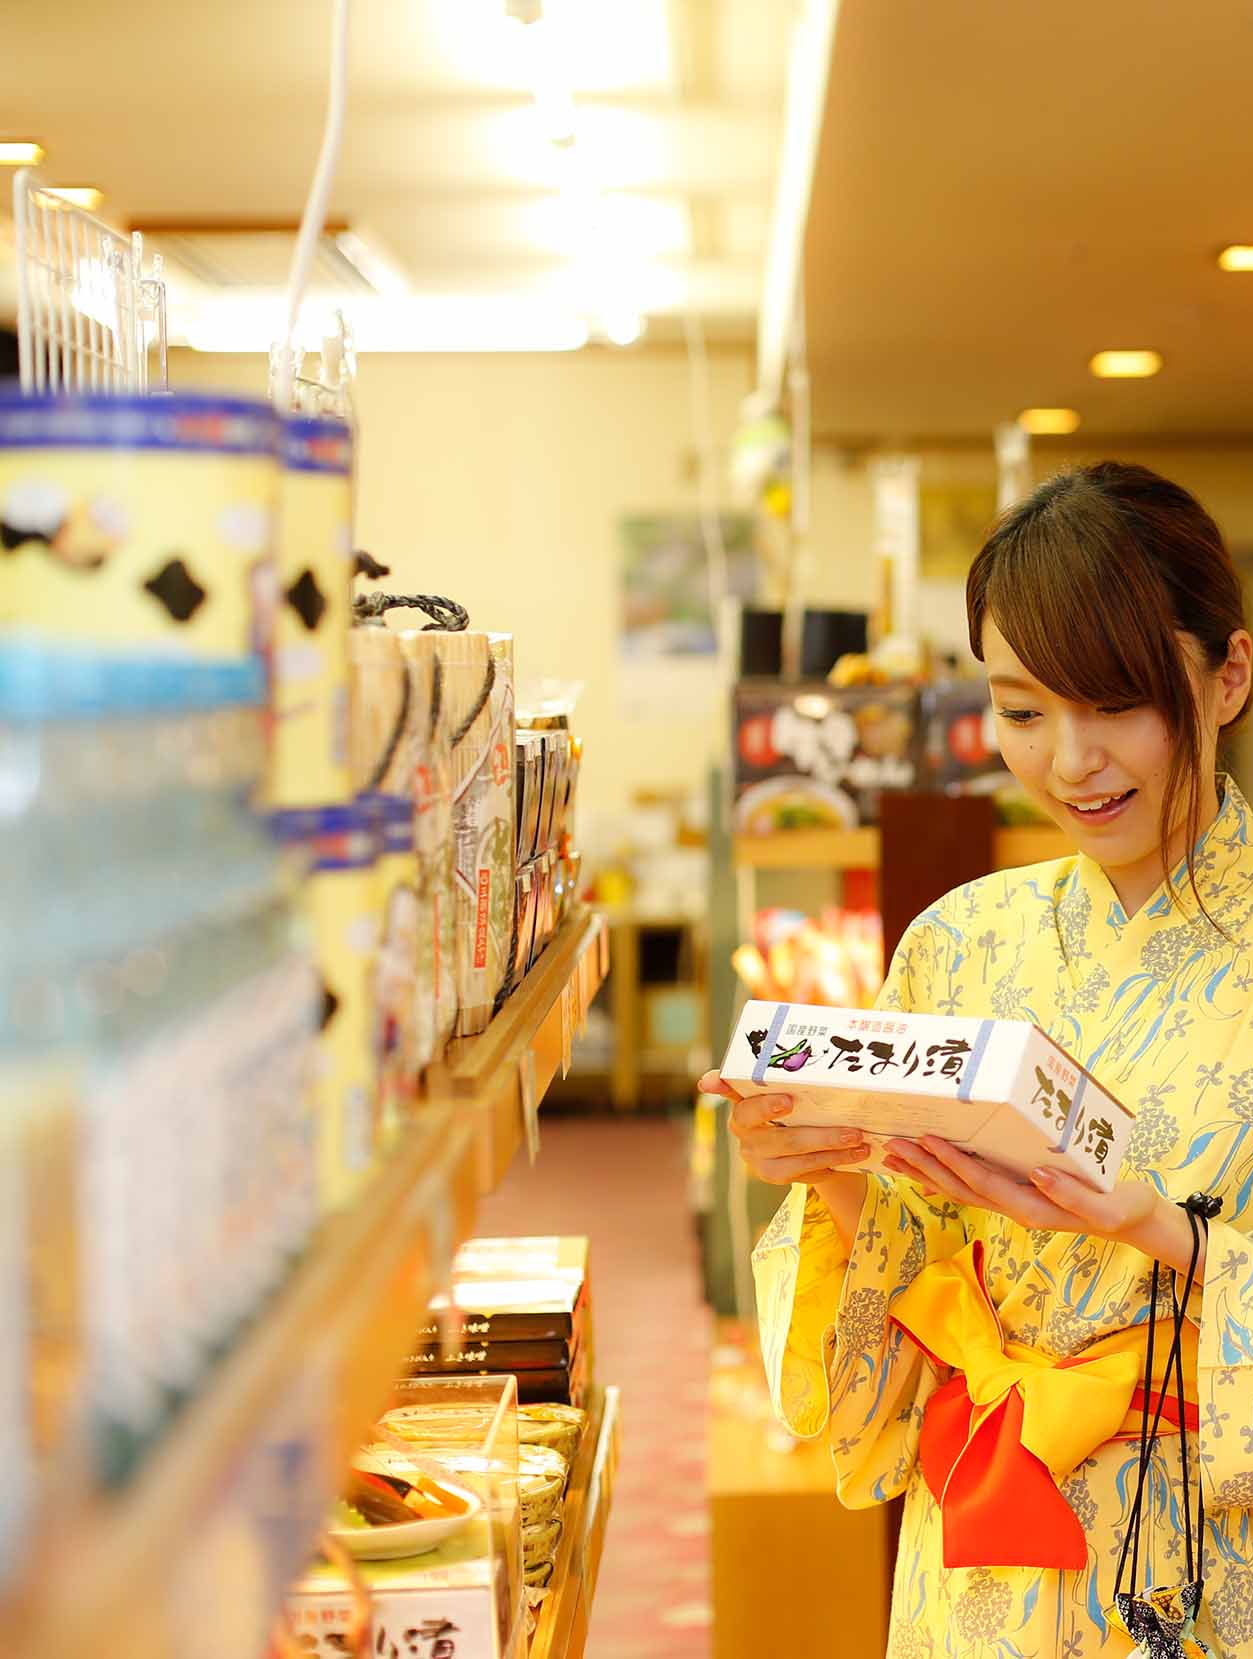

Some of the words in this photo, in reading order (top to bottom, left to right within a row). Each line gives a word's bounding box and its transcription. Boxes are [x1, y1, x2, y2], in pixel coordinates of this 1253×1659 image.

[785, 1023, 828, 1037] 国産野菜
[828, 1036, 972, 1084] たまり漬
